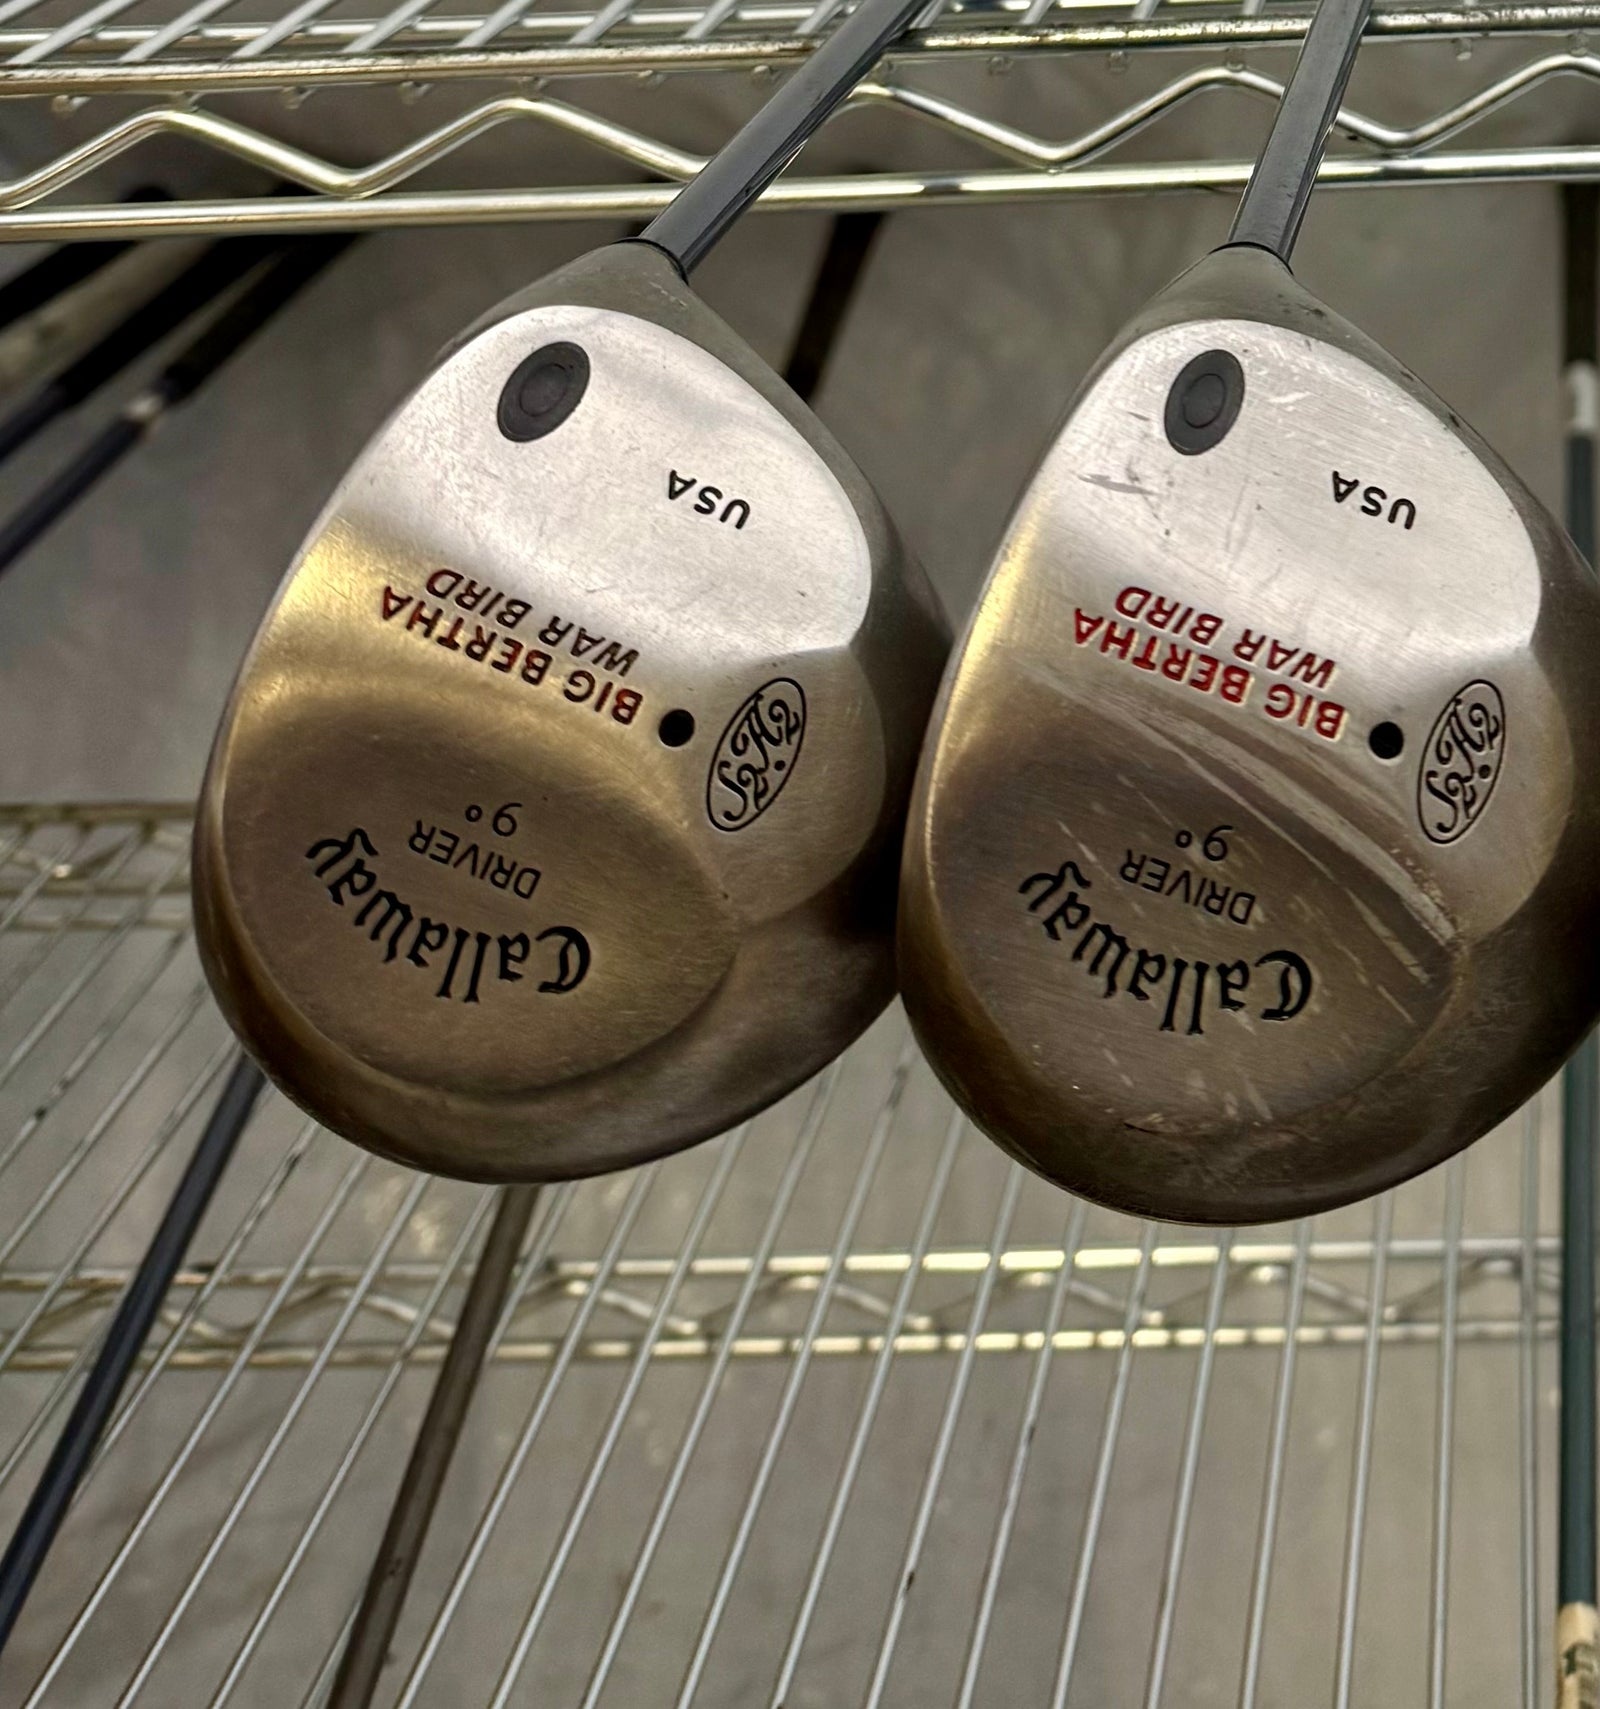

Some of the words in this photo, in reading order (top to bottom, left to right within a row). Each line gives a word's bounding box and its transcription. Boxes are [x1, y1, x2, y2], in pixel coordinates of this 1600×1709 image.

[667, 470, 751, 530] USA
[1331, 470, 1417, 530] USA
[424, 568, 532, 628] BIRD
[1115, 585, 1224, 648] BIRD
[380, 586, 557, 684] BERTHA
[538, 615, 640, 676] WAR
[1073, 608, 1255, 704] BERTHA
[1235, 629, 1337, 689] WAR
[562, 670, 644, 726] BIG
[1263, 683, 1346, 740] BIG
[408, 819, 542, 899] DRIVER
[1119, 849, 1256, 925] DRIVER
[305, 828, 591, 1003] Callaway
[1018, 860, 1313, 1036] Callaway
